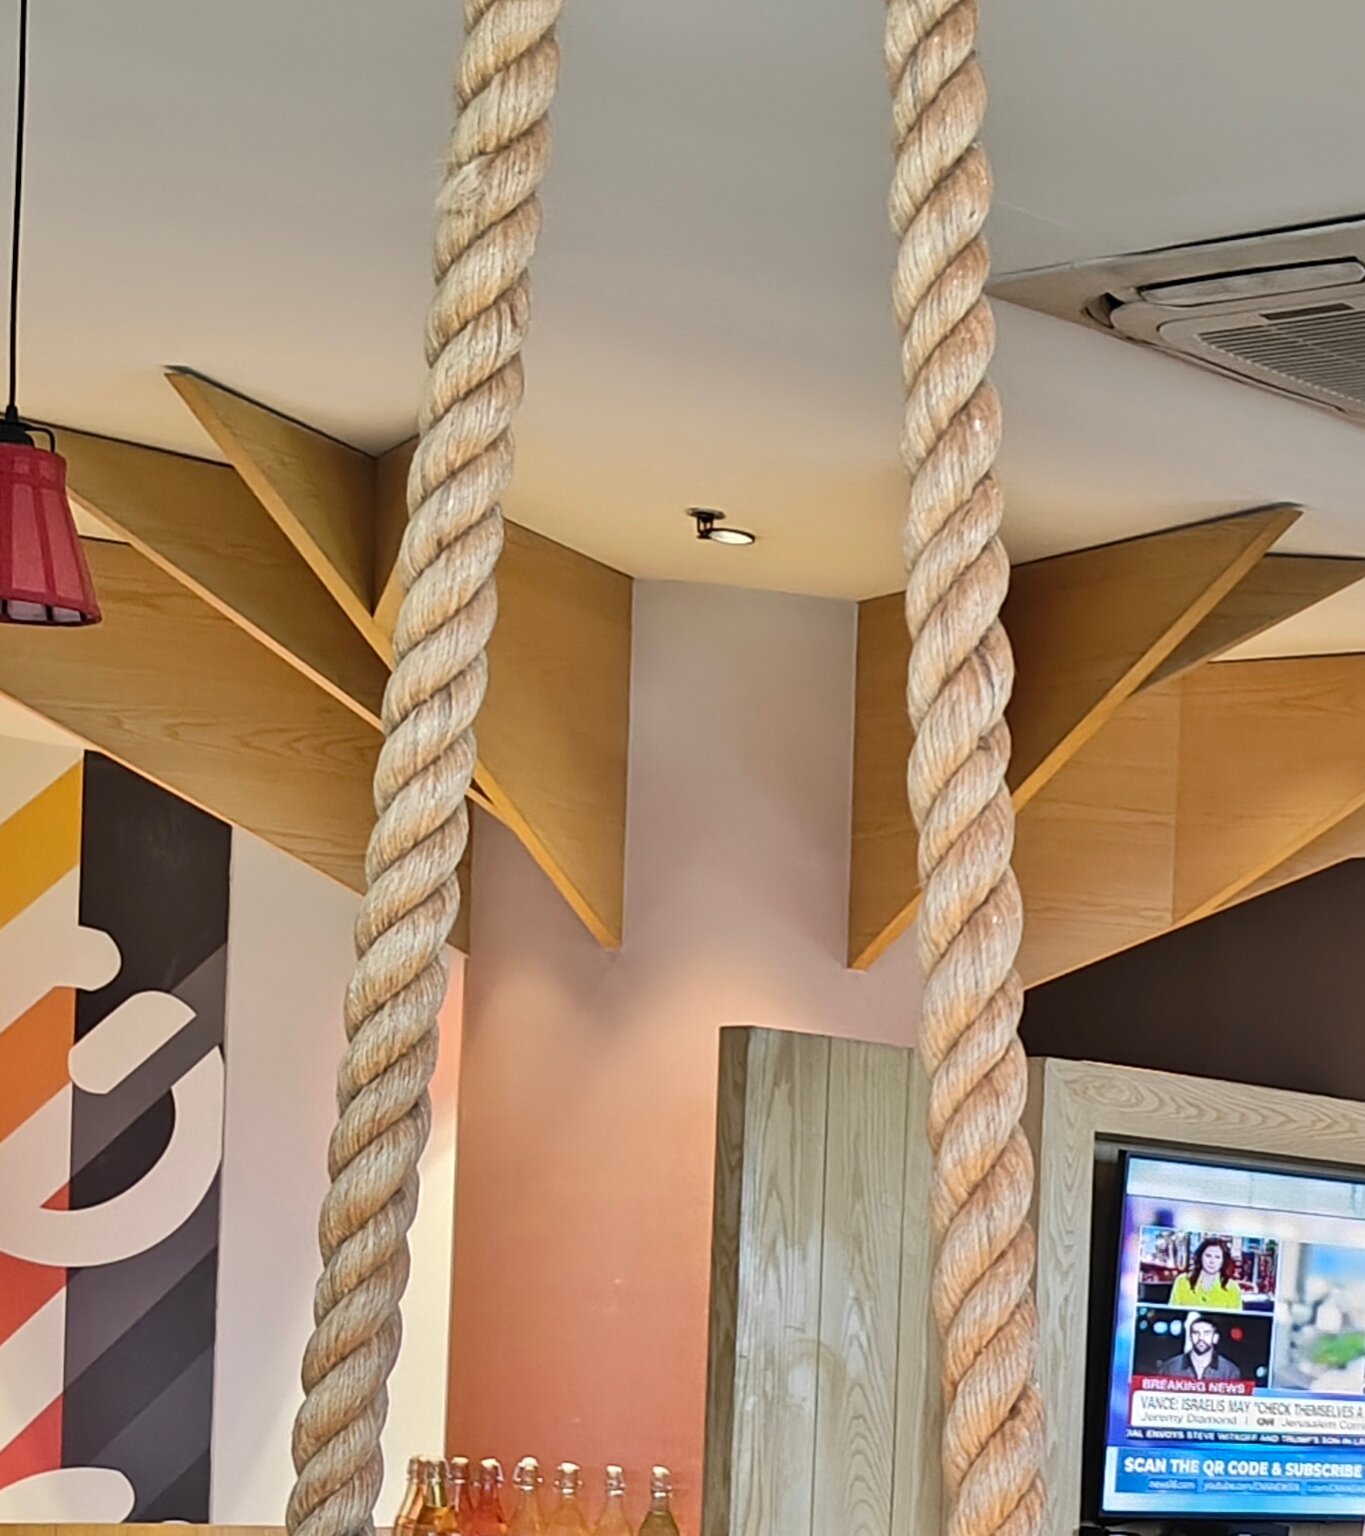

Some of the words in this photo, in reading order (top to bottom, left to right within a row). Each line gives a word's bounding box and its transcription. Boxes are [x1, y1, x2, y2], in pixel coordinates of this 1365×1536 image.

[1142, 1378, 1206, 1393] BREAKING
[1208, 1382, 1246, 1395] NEWS
[1228, 1399, 1252, 1414] MAY
[1295, 1403, 1355, 1419] THEMSELVES
[1187, 1413, 1238, 1426] Diamond
[1124, 1456, 1167, 1473] SCAN
[1169, 1458, 1200, 1474] THE
[1202, 1460, 1225, 1477] QR
[1227, 1460, 1269, 1476] CODE
[1271, 1461, 1282, 1478] &
[1285, 1462, 1363, 1479] SUBSCRIBE
